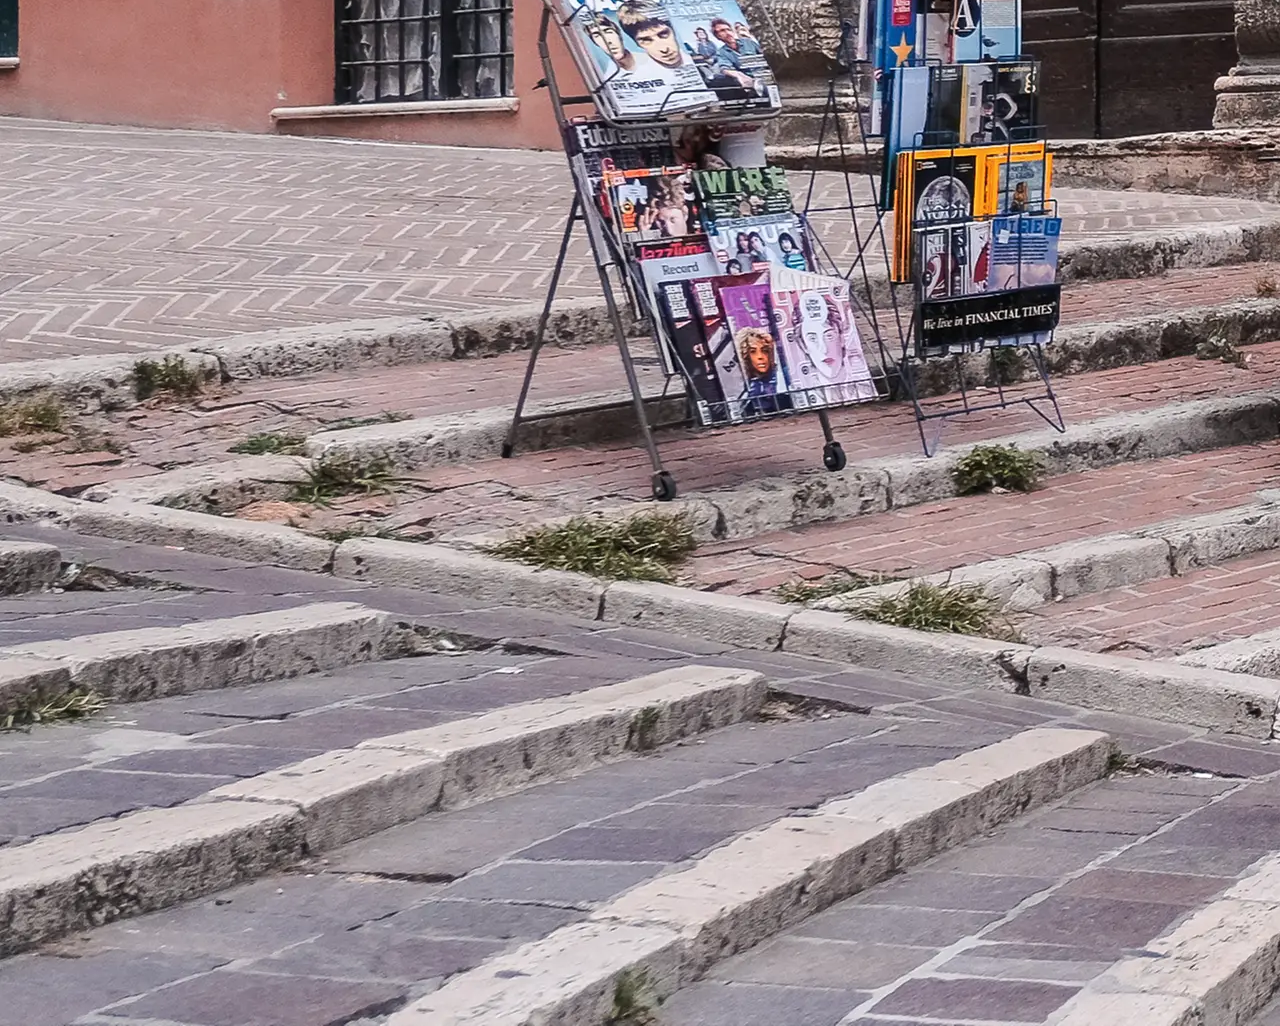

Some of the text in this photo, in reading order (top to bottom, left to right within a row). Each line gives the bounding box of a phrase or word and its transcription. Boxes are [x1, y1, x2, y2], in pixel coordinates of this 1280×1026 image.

[610, 78, 666, 92] LIVE FOREVER
[702, 166, 788, 196] WIRE
[662, 261, 699, 275] Record
[923, 319, 935, 330] We
[954, 317, 963, 326] in
[965, 311, 1021, 325] FINANCIAL
